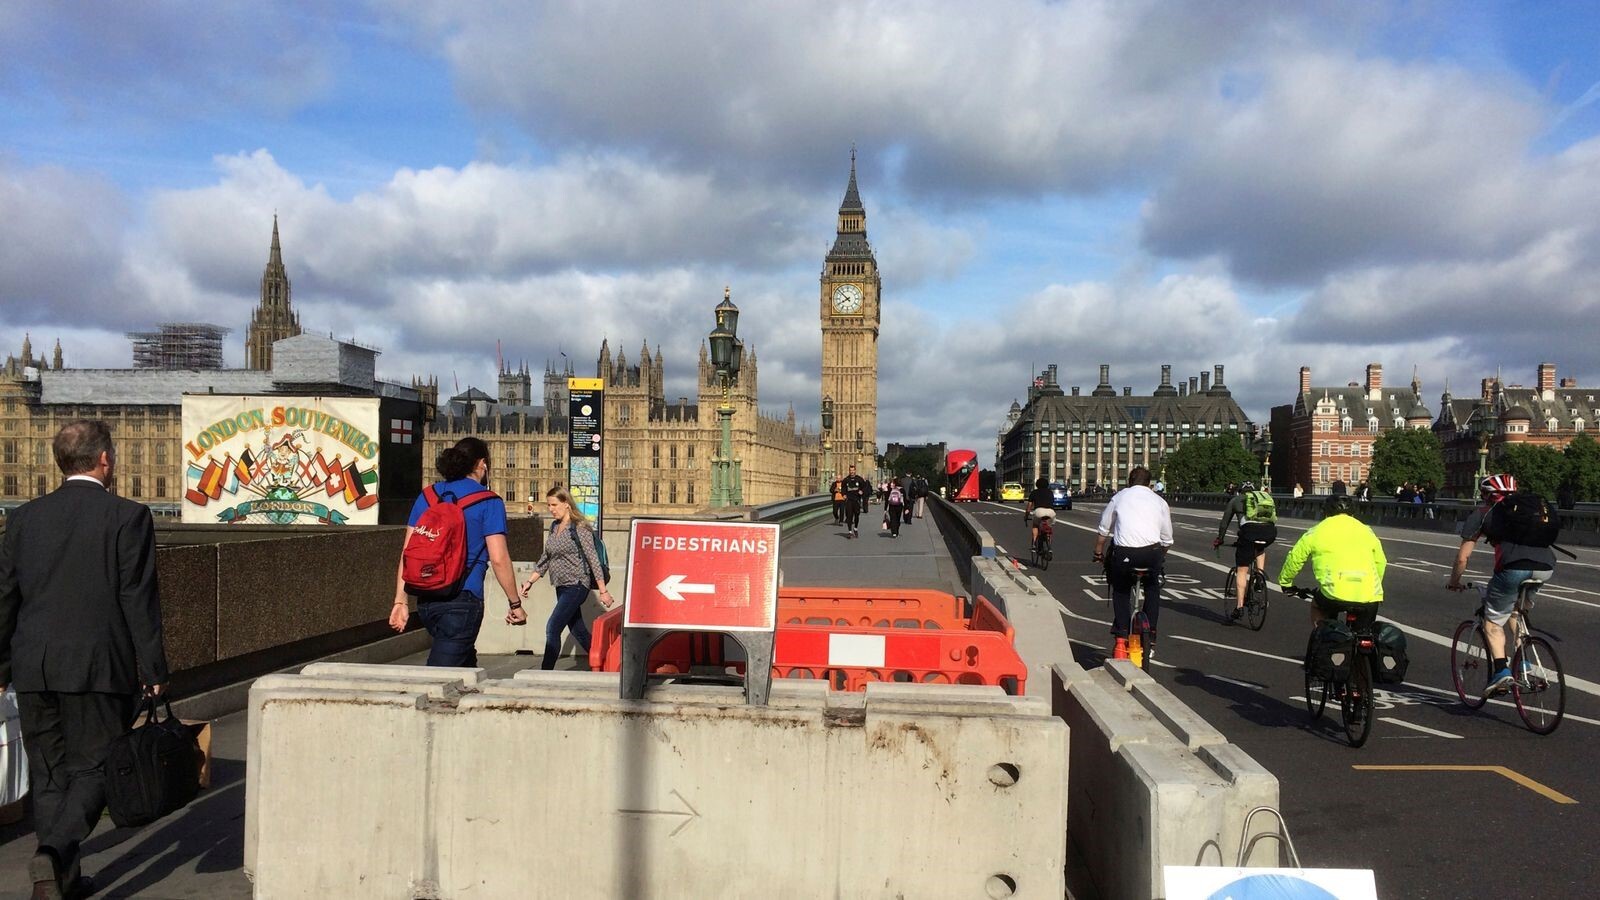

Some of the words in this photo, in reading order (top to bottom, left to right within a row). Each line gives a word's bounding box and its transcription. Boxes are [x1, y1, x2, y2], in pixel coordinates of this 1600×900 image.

[184, 407, 265, 460] LONDON
[272, 405, 379, 459] SOUVENIRS
[251, 501, 314, 513] LONDON
[641, 535, 768, 554] PEDESTRIANS
